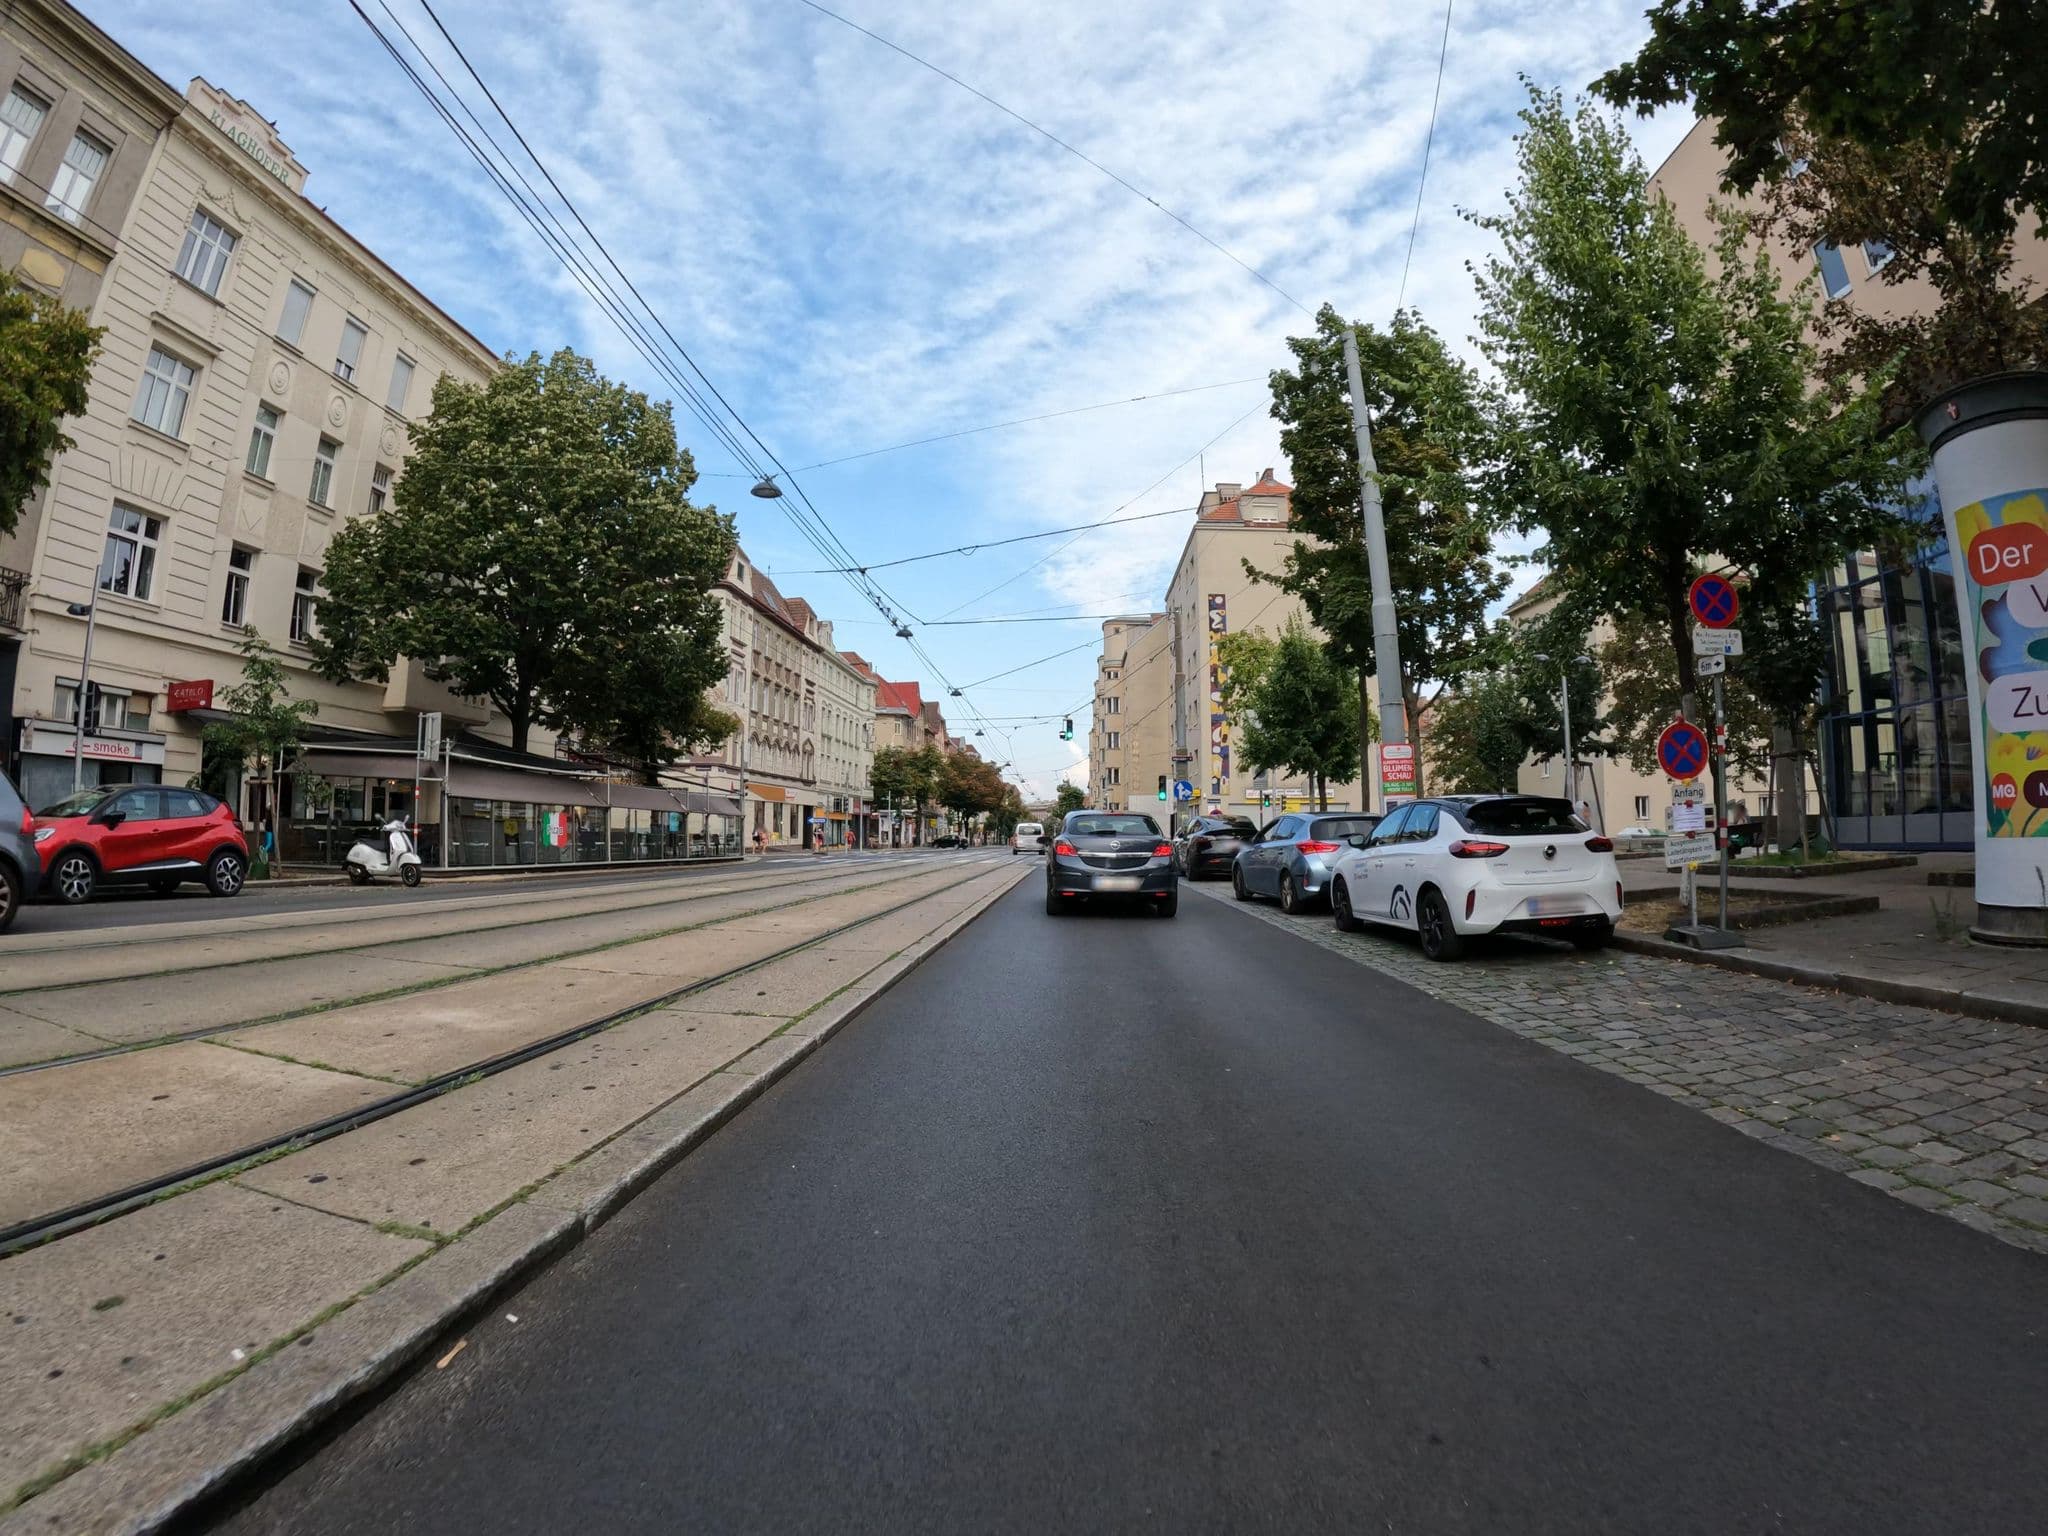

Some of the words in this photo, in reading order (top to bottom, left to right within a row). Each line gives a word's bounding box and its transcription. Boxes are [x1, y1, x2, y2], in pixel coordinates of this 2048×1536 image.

[210, 109, 289, 183] KLAGHOFER
[1978, 543, 2033, 575] Der
[93, 742, 130, 755] smoke
[1383, 764, 1415, 773] BLUMEN-
[1387, 772, 1412, 781] SCHAU
[1674, 788, 1704, 798] Anfang
[1992, 784, 2016, 799] MQ
